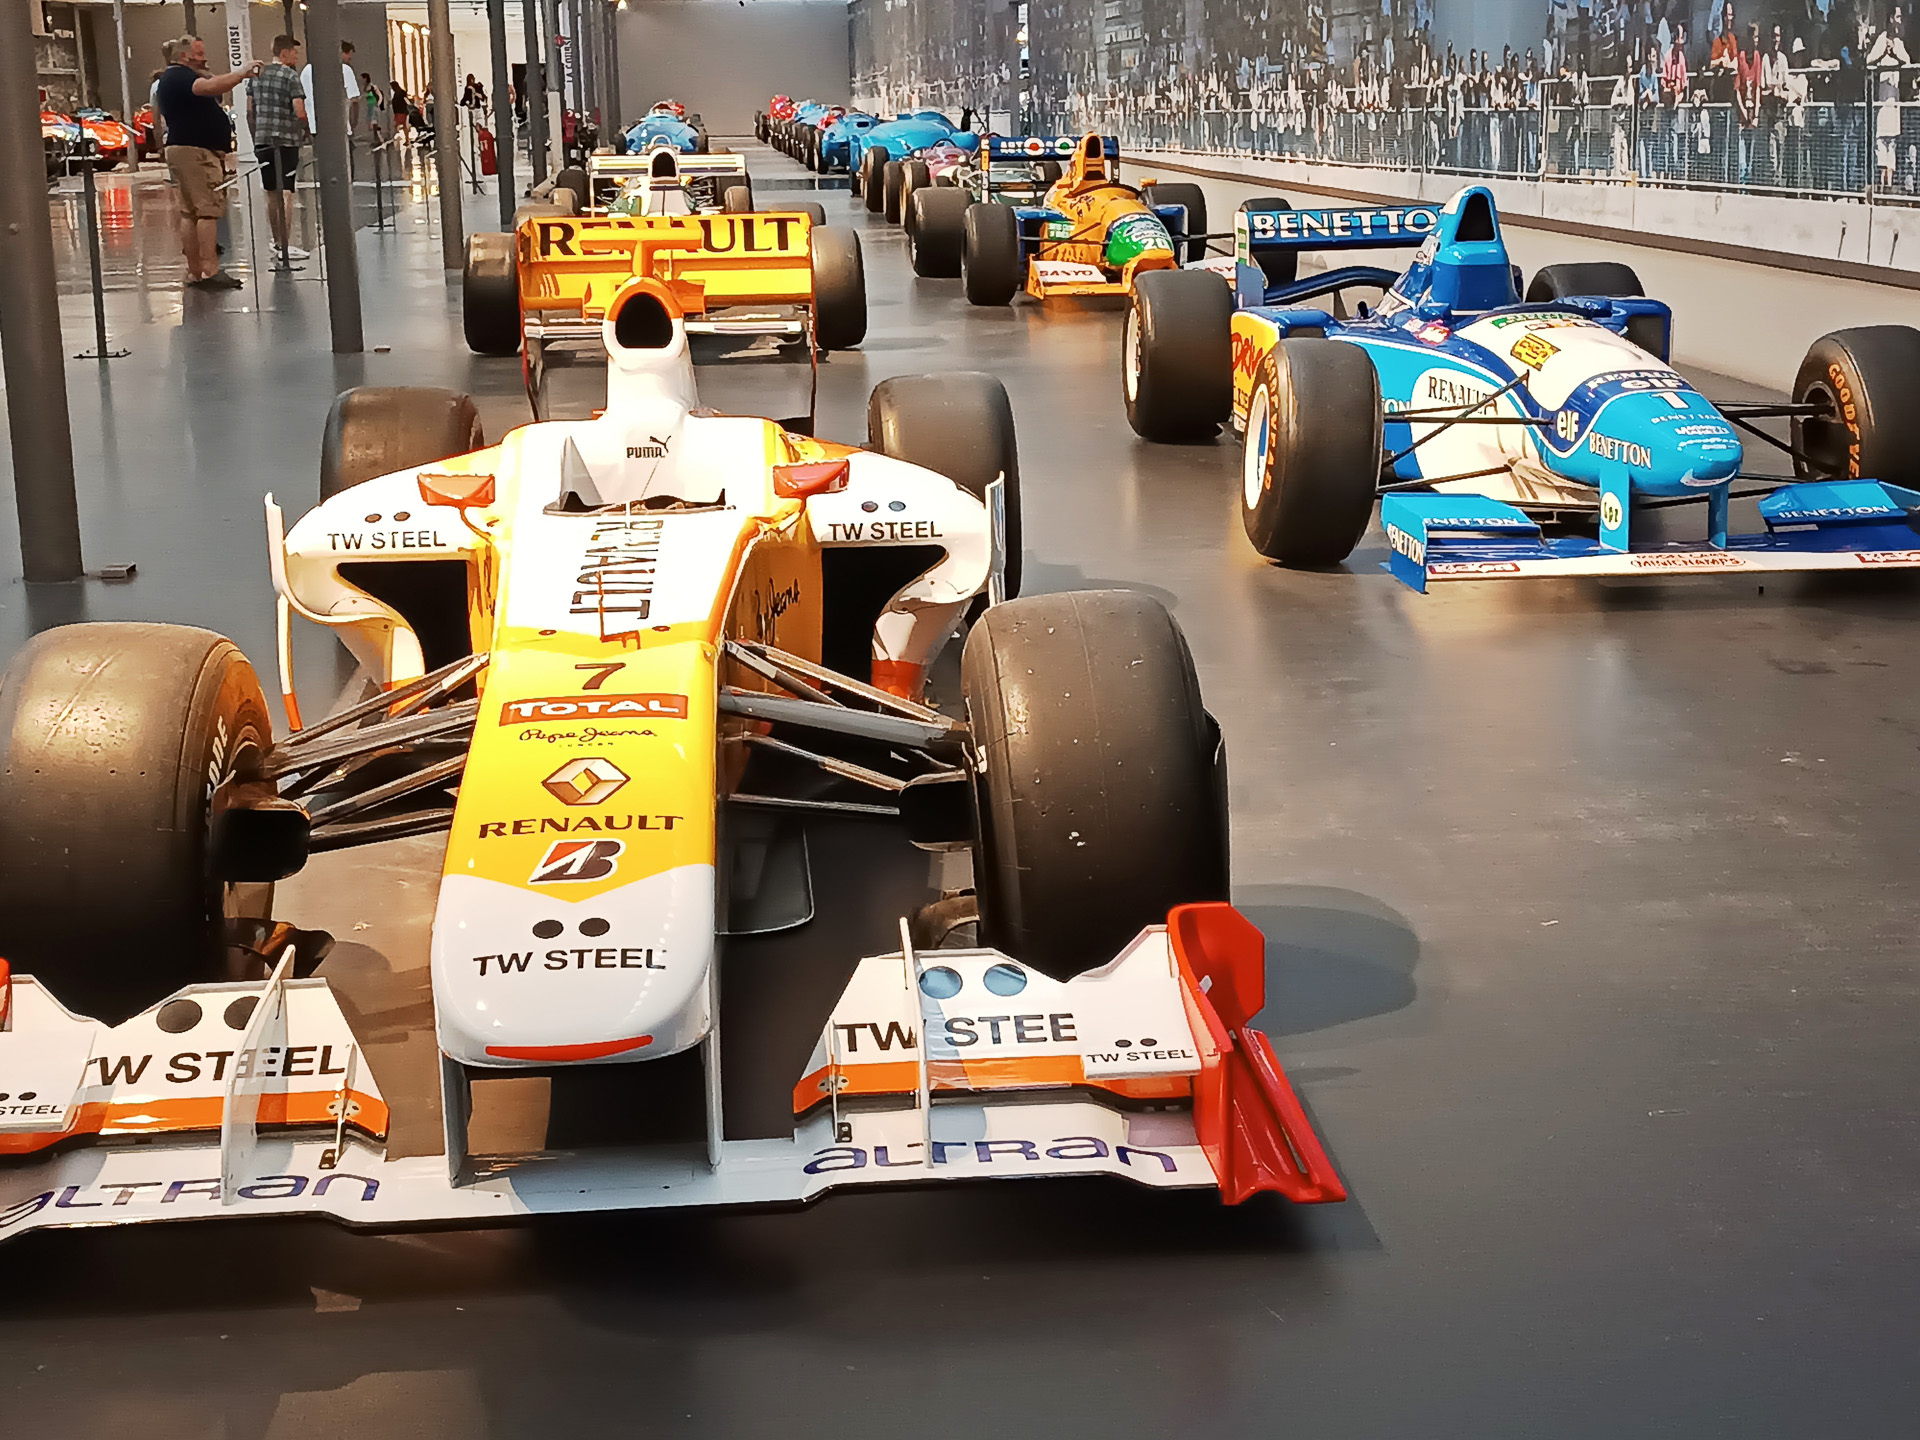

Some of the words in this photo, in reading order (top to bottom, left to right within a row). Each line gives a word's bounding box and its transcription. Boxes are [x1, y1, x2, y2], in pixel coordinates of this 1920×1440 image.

[538, 217, 801, 256] RULT
[1252, 208, 1442, 239] BENETTO
[1650, 391, 1690, 409] 1
[1556, 410, 1580, 443] elf
[1828, 363, 1860, 481] GOODYE
[626, 446, 662, 459] PUMA
[1589, 431, 1652, 470] BENETTON
[1779, 505, 1891, 519] BENETTON
[327, 533, 363, 550] TW
[371, 530, 446, 550] STEEL
[827, 523, 864, 541] TW
[870, 521, 943, 540] STEEL
[575, 662, 627, 691] 7
[509, 700, 681, 717] TOTAL
[519, 729, 578, 743] Pepe
[579, 727, 657, 743] Jeans
[478, 814, 684, 840] RENAULT
[472, 952, 534, 977] TW
[543, 948, 667, 971] STEEL
[834, 1021, 918, 1052] TW
[944, 1013, 1079, 1047] STEE
[1086, 1053, 1120, 1063] TW
[1126, 1049, 1193, 1061] STEEL
[88, 1054, 153, 1086] W
[0, 1104, 63, 1115] STEEL
